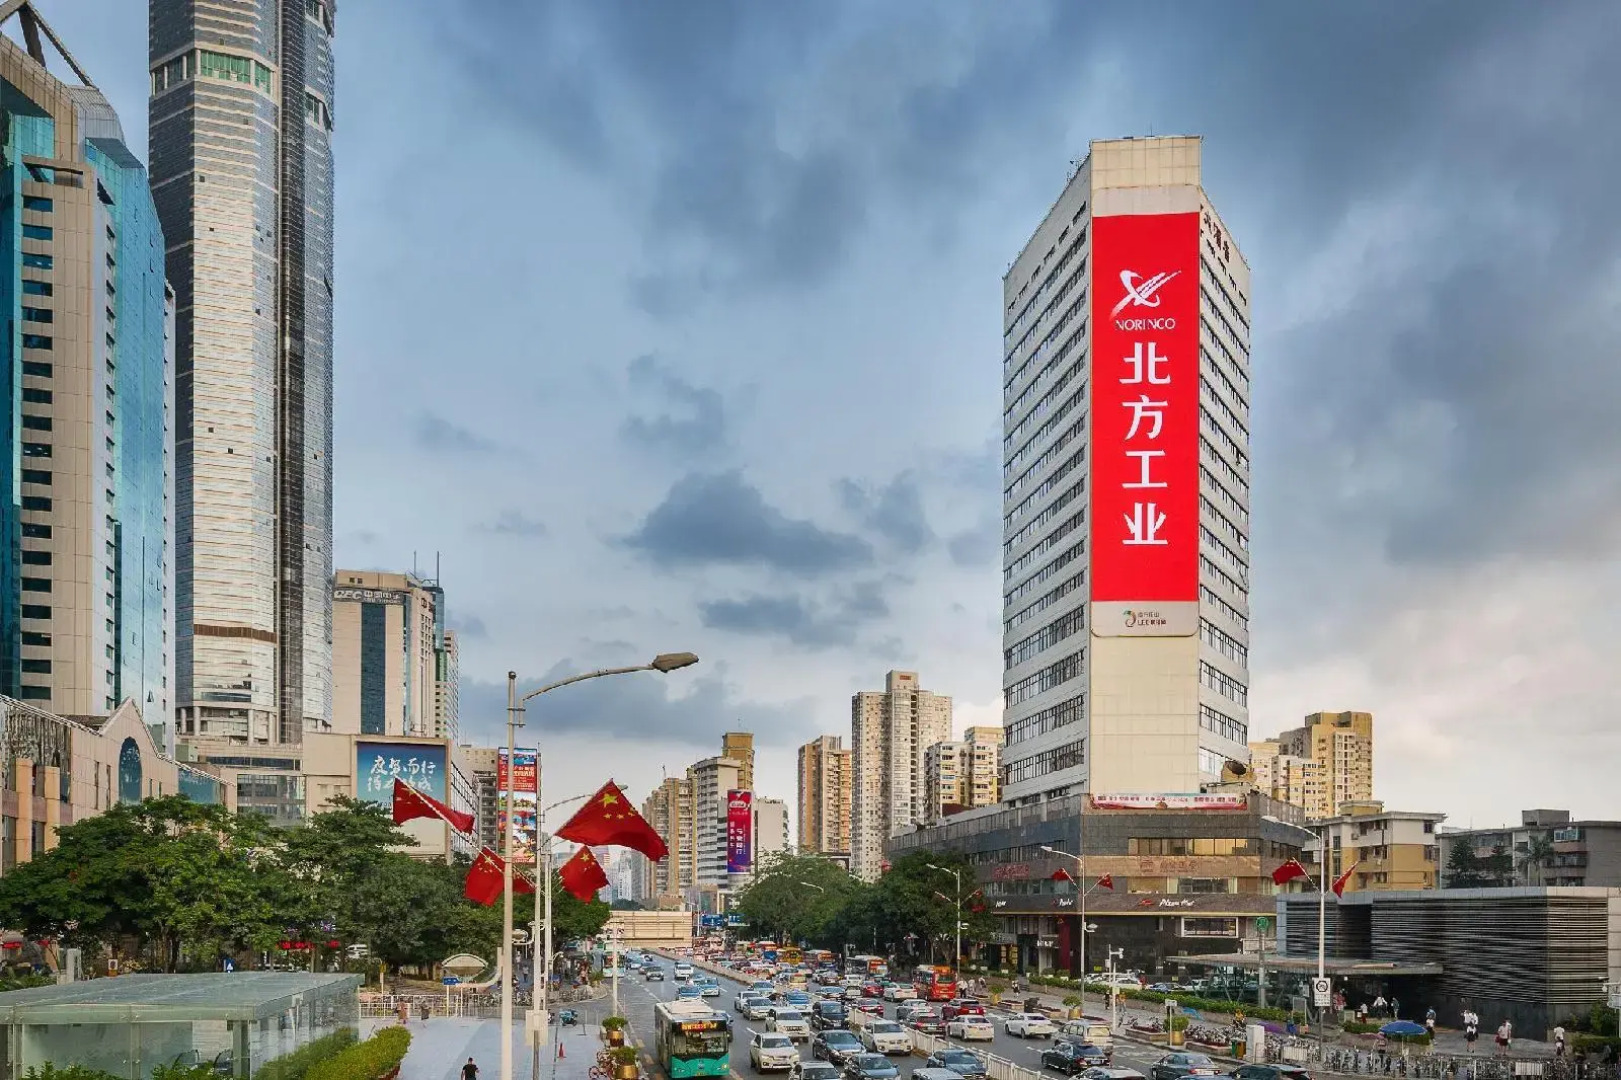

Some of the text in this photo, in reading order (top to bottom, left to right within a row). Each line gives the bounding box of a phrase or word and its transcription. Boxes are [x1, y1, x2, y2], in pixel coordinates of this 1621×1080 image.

[1115, 317, 1176, 331] NORINCO
[1119, 341, 1171, 545] 北方工业
